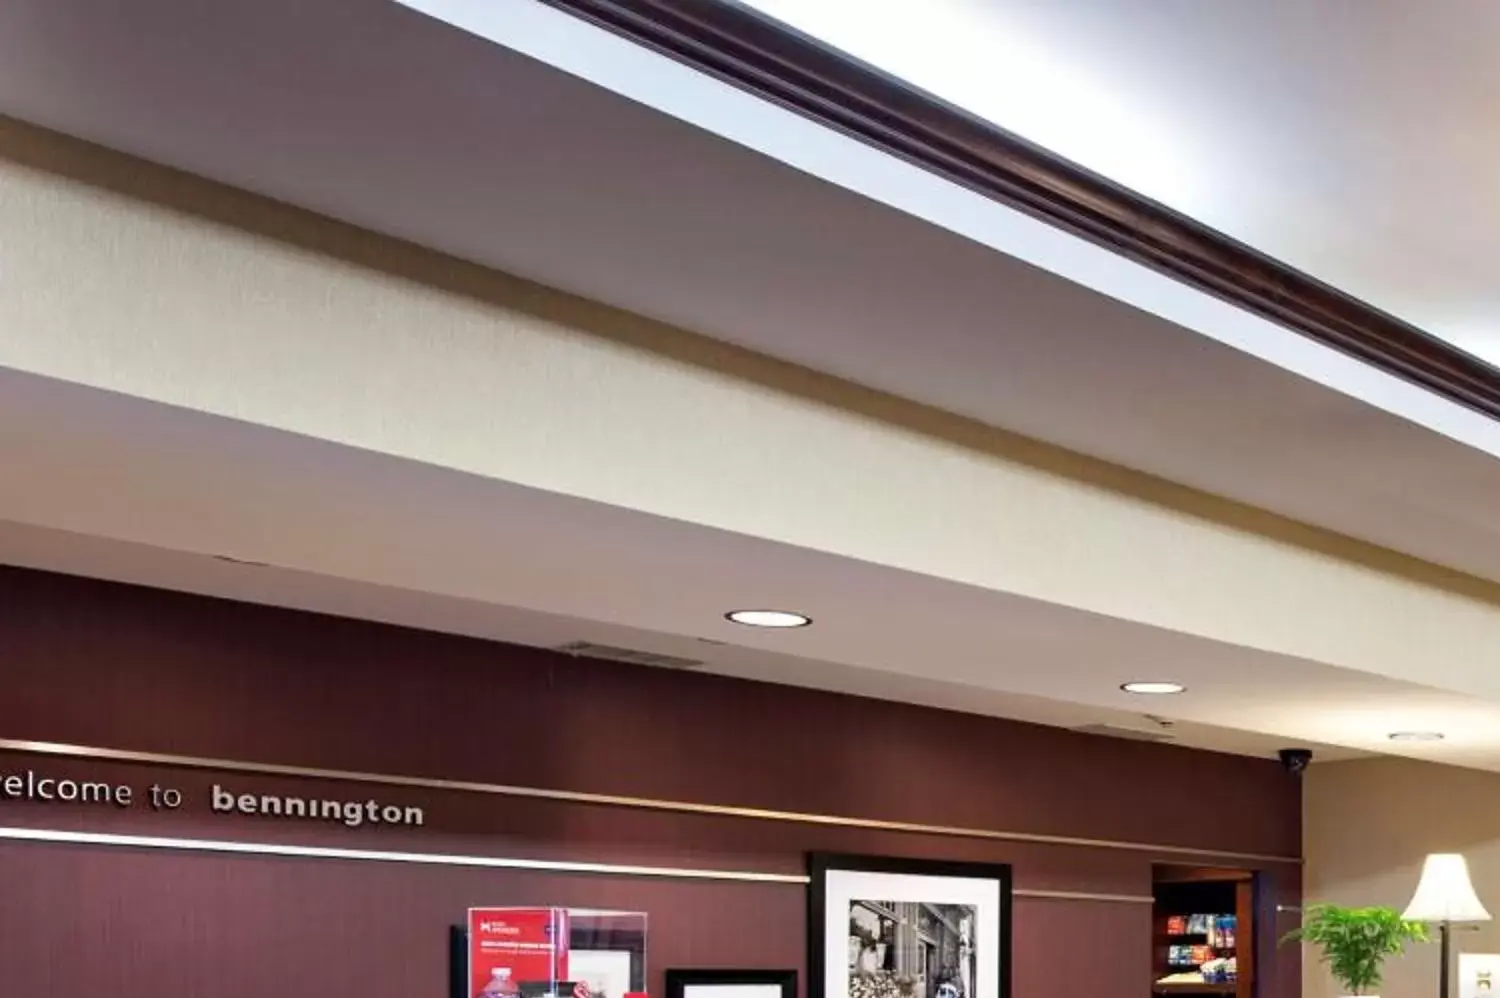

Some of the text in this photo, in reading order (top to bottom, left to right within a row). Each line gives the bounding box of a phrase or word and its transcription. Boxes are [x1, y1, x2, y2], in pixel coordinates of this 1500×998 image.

[0, 770, 424, 826] elcome to bennington
